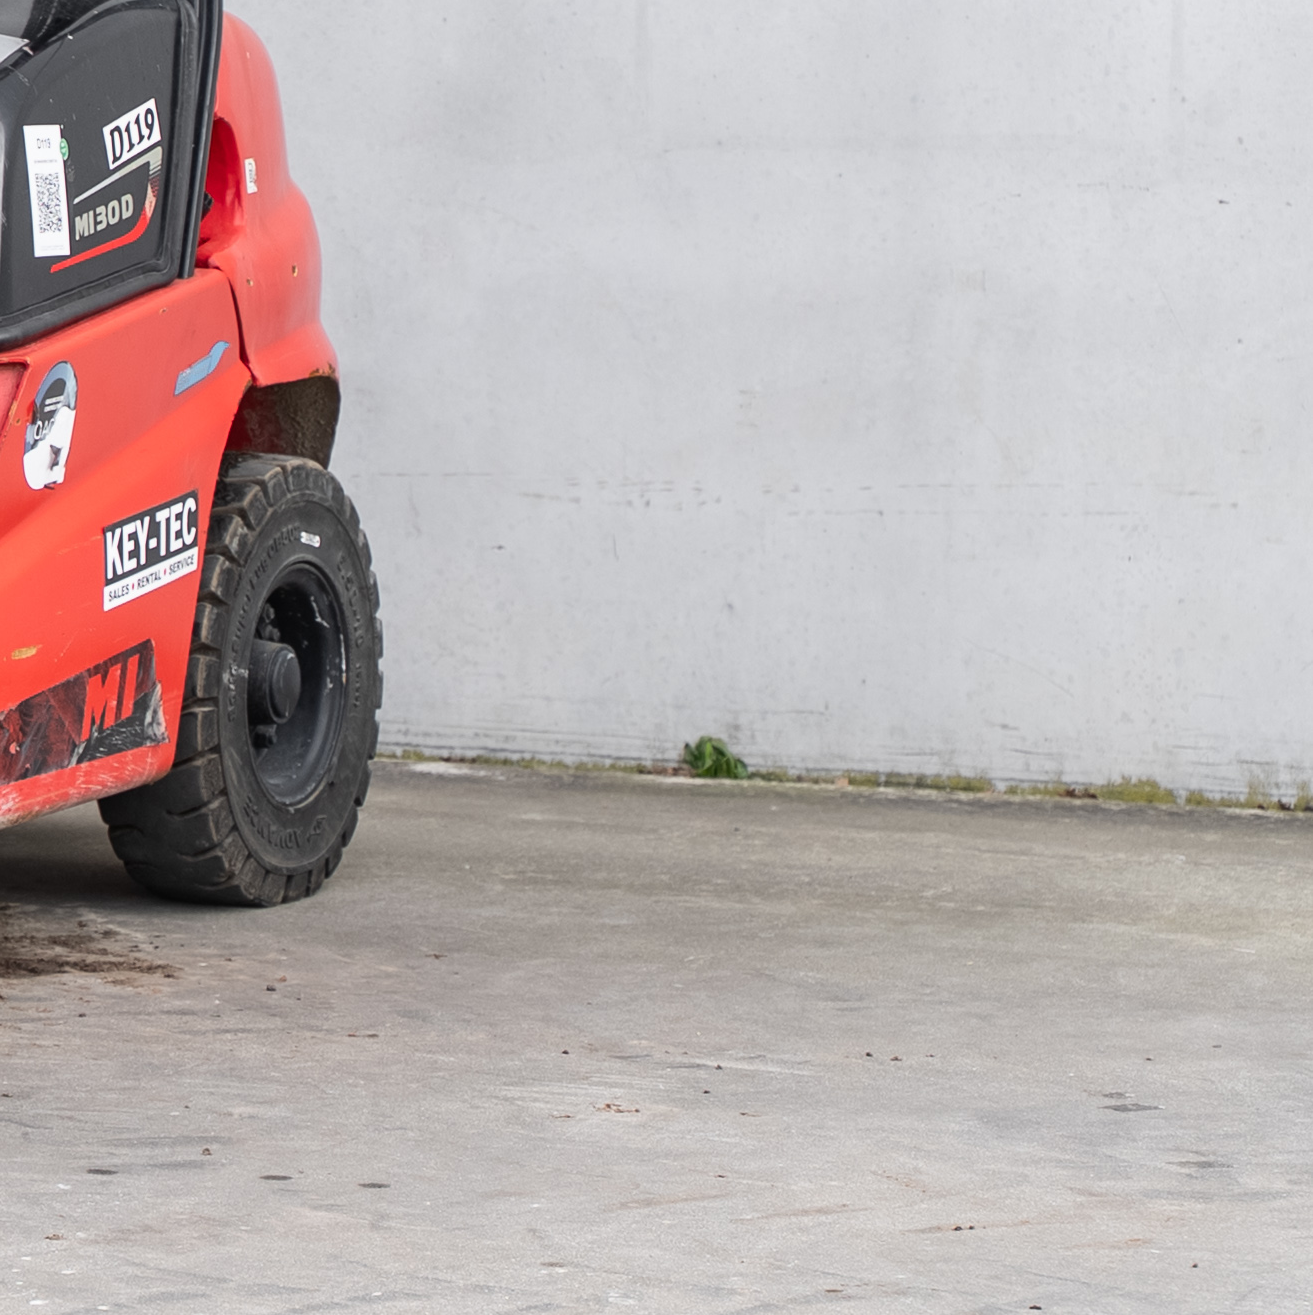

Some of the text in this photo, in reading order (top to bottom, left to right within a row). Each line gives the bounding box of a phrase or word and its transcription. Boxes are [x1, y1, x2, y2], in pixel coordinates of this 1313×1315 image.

[36, 138, 51, 149] D119
[110, 107, 155, 165] D119
[105, 497, 197, 580] KEY-TEC
[108, 553, 195, 603] SALES RENTAL SERVICE
[80, 653, 140, 742] MI
